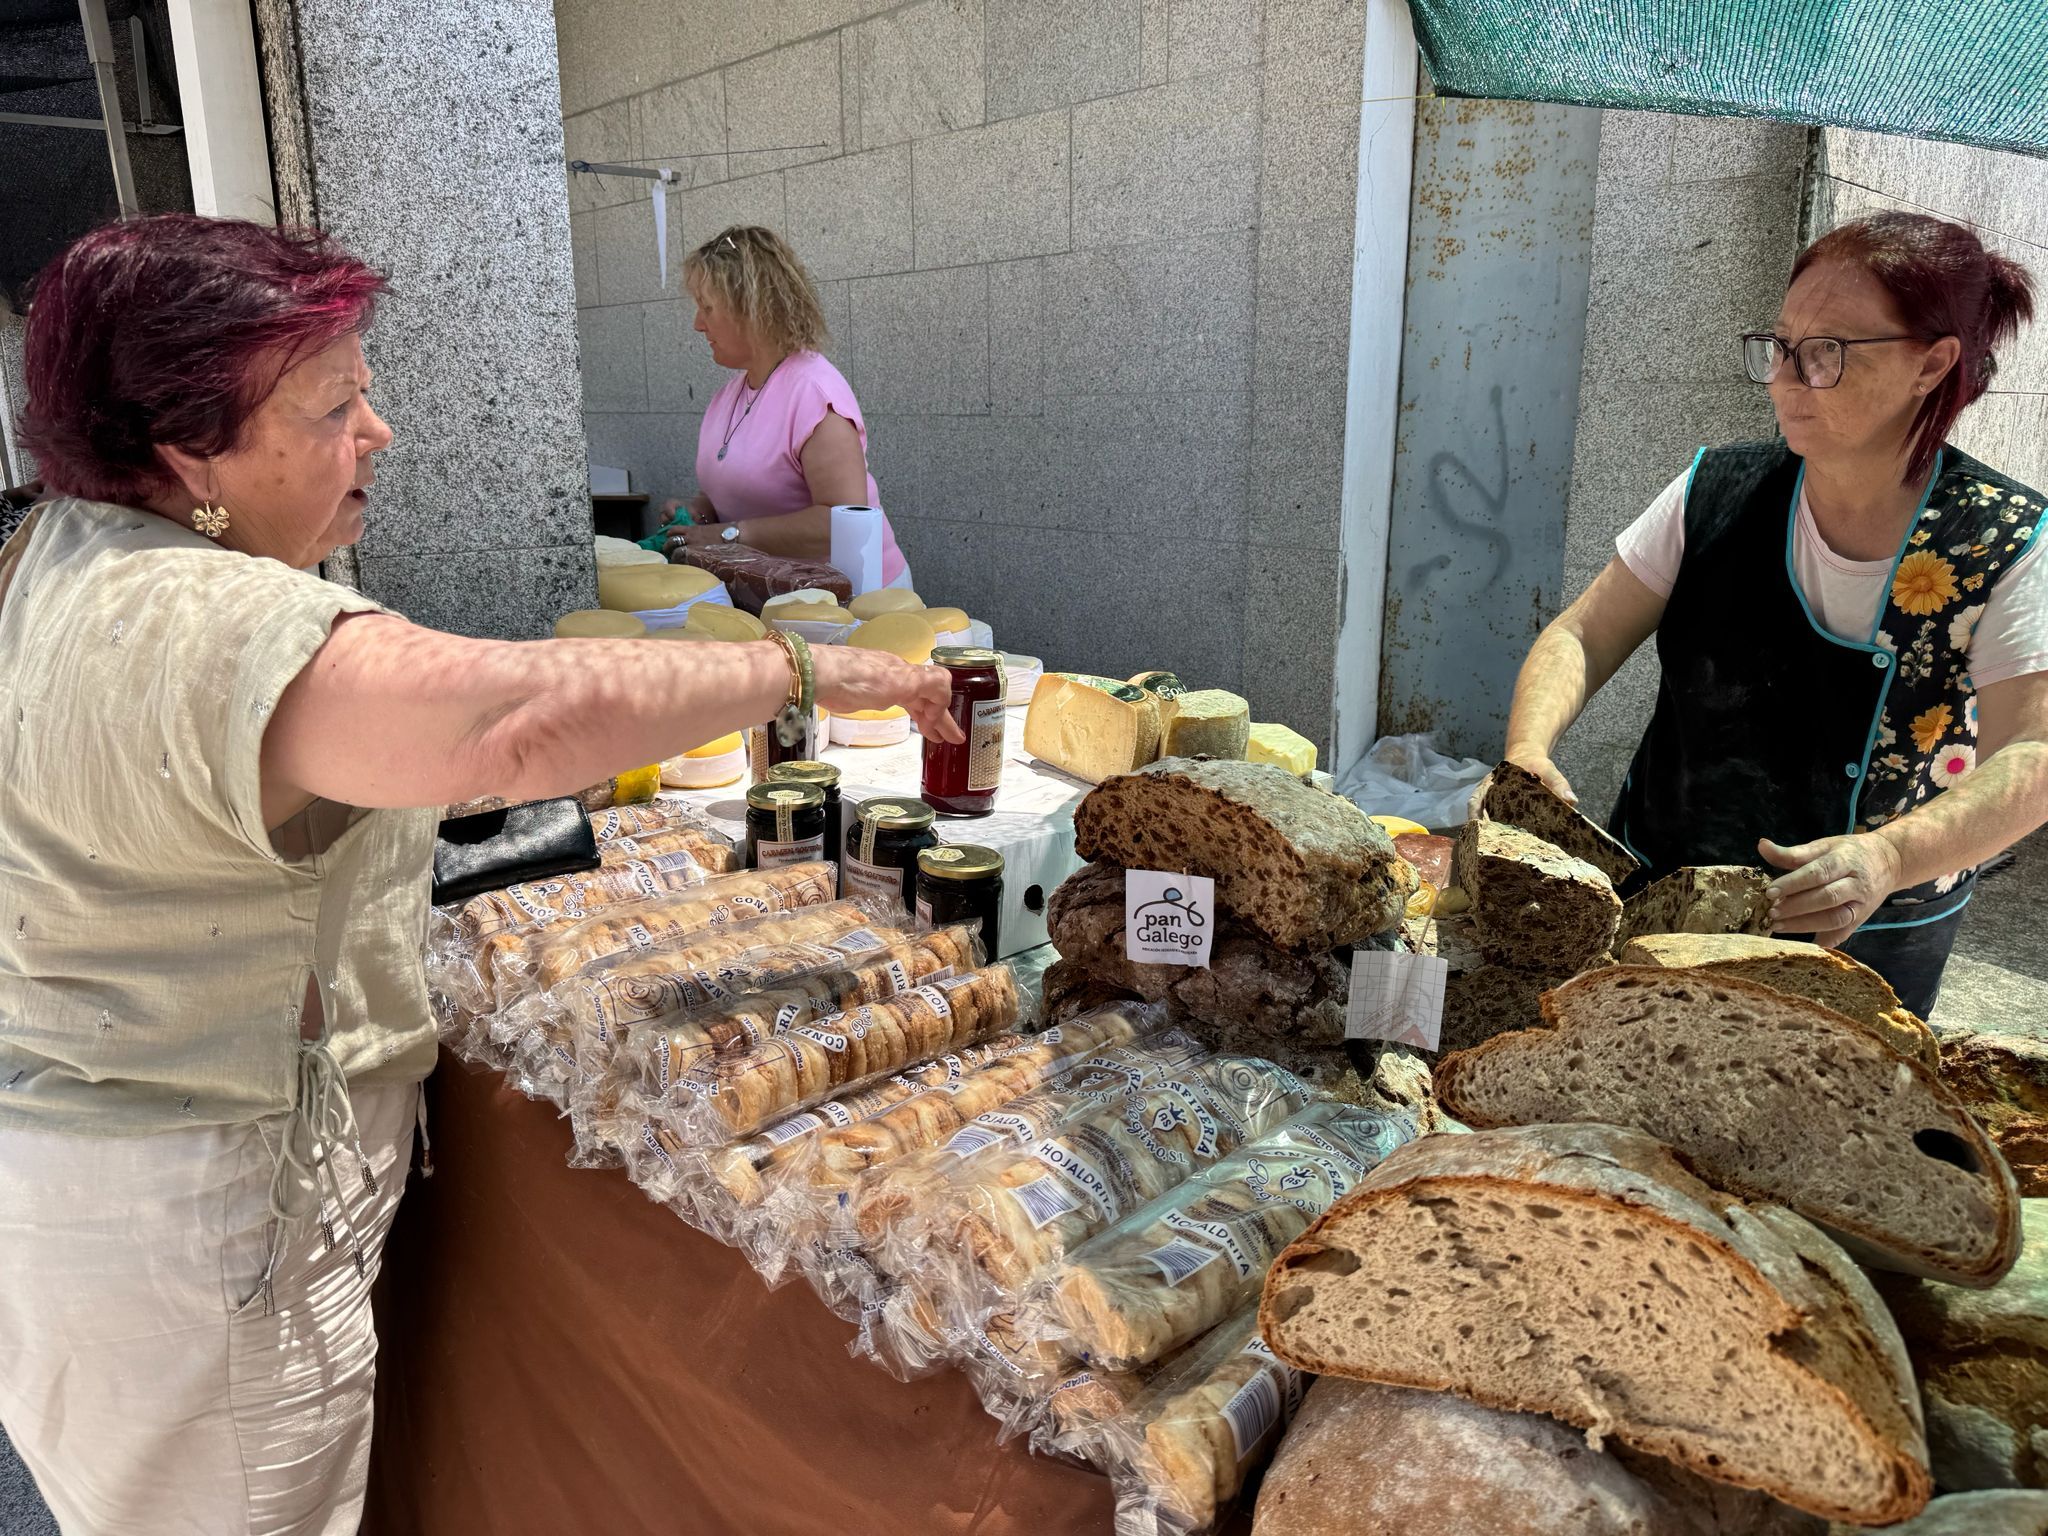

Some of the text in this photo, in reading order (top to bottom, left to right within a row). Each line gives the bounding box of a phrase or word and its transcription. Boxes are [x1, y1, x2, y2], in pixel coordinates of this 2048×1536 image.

[1145, 914, 1181, 930] pan
[1137, 927, 1203, 949] Galego
[594, 997, 606, 1042] FABRICADO
[1156, 1111, 1173, 1129] AS
[1040, 1143, 1114, 1217] HOJALDRITA
[1286, 1177, 1301, 1186] AS
